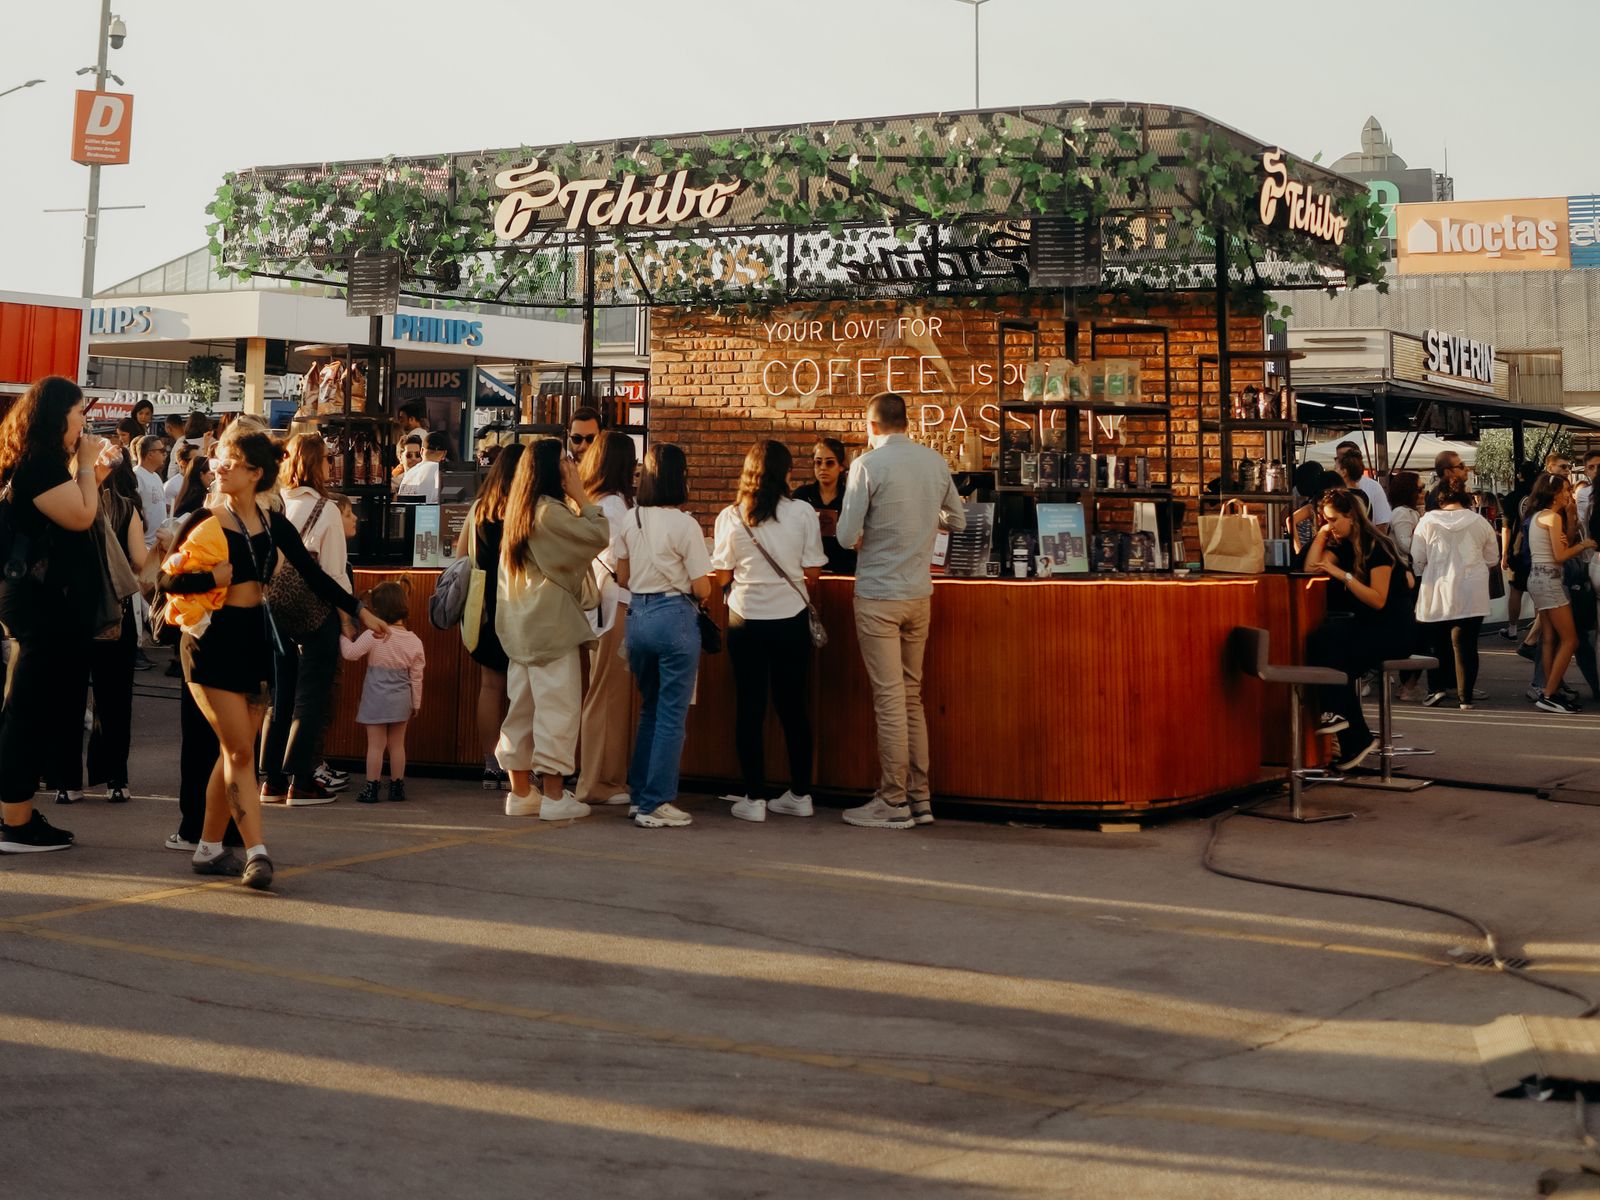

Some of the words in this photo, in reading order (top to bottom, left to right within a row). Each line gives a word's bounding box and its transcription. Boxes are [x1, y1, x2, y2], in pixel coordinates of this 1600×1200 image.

[85, 95, 124, 136] D
[558, 170, 742, 230] Tchibo
[1285, 181, 1349, 246] Tchibo
[90, 306, 151, 335] LIPS
[393, 314, 484, 347] PHILIPS
[763, 321, 823, 343] YOUR
[832, 319, 888, 342] LOVE
[898, 317, 943, 339] FOR
[763, 355, 944, 396] COFFEE
[971, 364, 993, 385] IS
[1423, 328, 1495, 384] SEVERIN
[396, 372, 461, 389] PHILIPS
